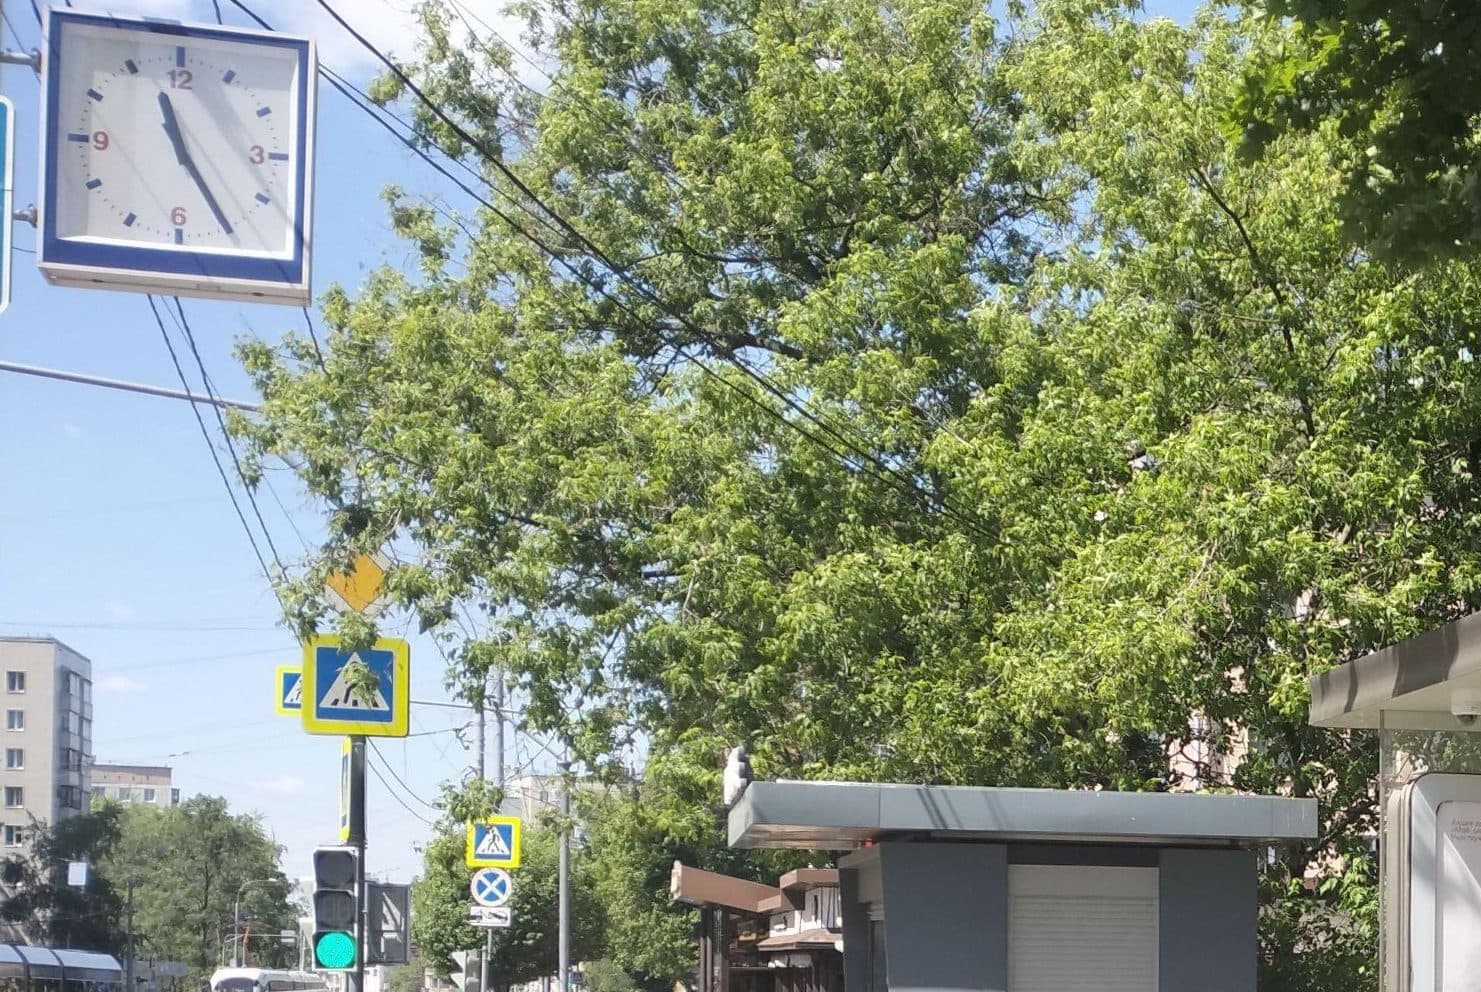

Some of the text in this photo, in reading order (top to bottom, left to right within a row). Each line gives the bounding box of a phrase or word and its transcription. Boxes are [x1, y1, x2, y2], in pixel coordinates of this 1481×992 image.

[167, 70, 193, 91] 12
[93, 131, 110, 151] 9
[249, 145, 265, 165] 3
[170, 207, 188, 226] 6
